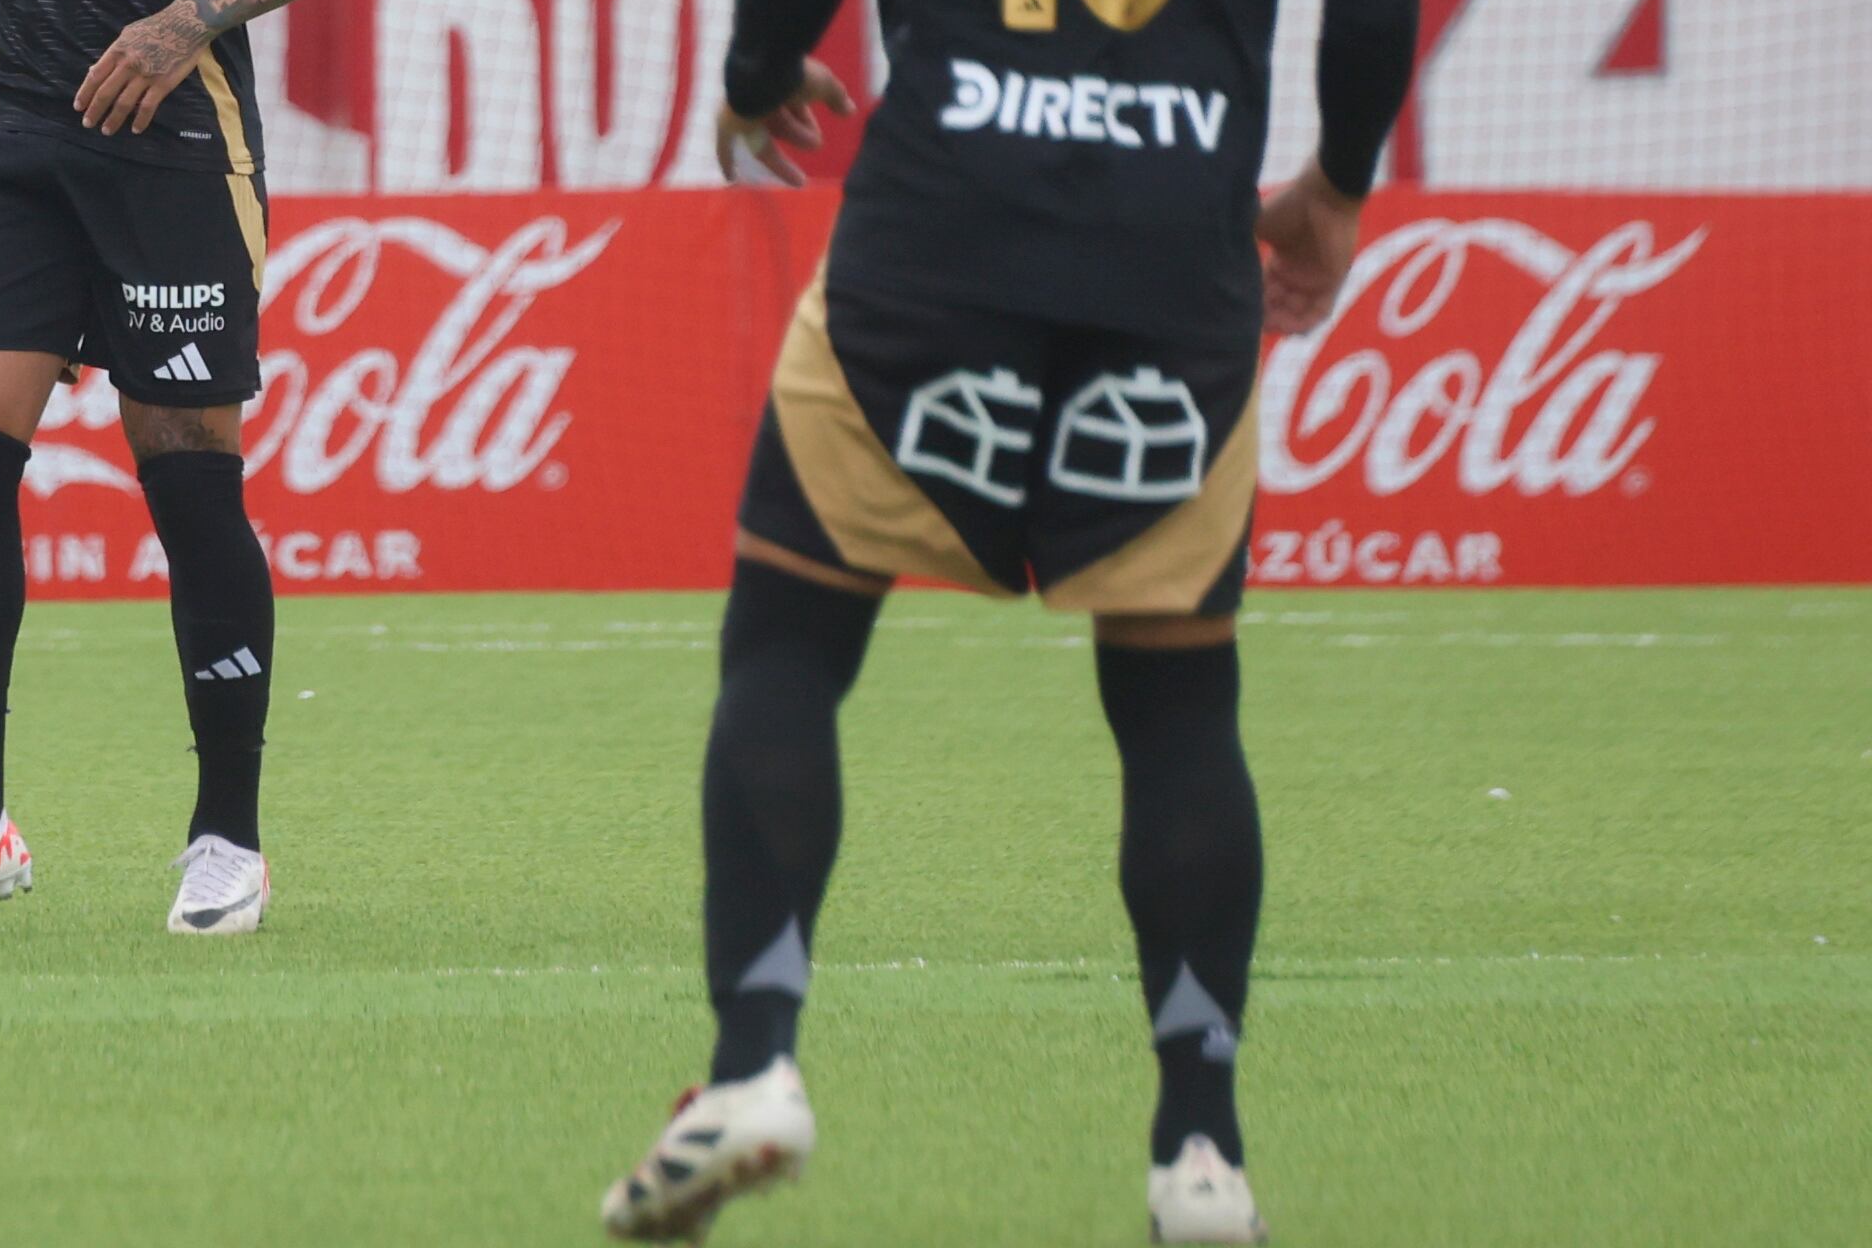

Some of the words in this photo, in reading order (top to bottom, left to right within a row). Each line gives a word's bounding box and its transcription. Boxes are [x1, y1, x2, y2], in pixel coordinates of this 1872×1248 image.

[940, 58, 1228, 152] DIRECTV
[122, 283, 225, 309] PHILIPS
[150, 313, 165, 332] &
[169, 312, 224, 332] Audio
[25, 533, 107, 583] IN
[129, 519, 426, 581] ACAR
[1245, 518, 1503, 584] ZÚCAR
